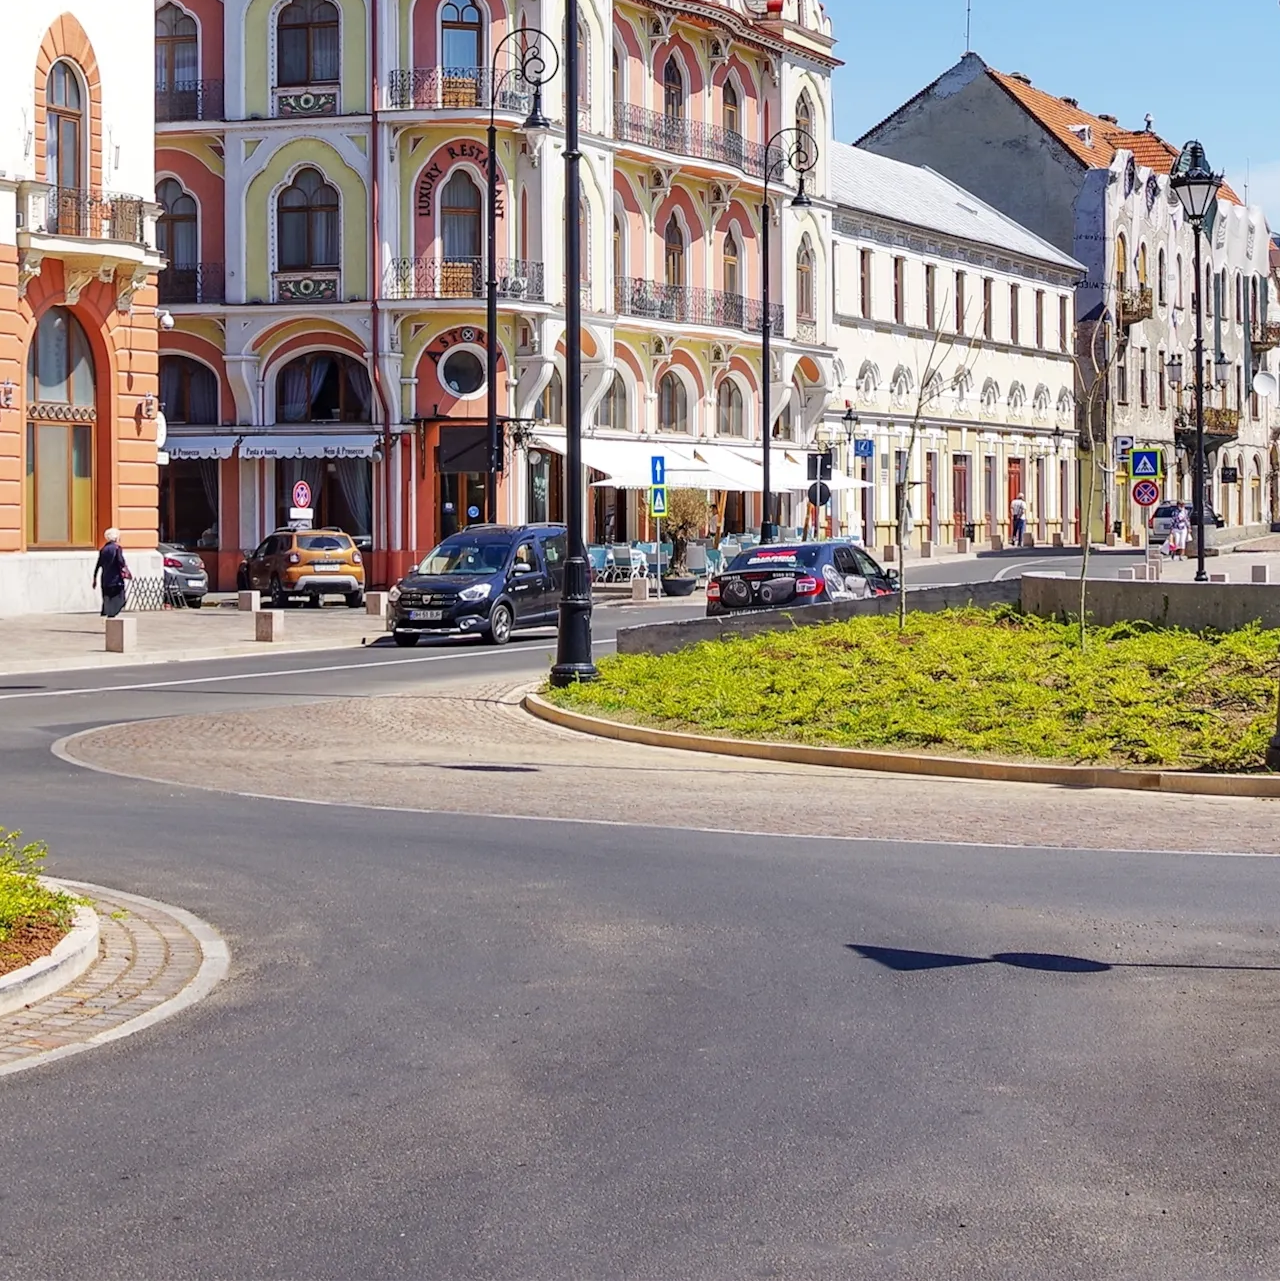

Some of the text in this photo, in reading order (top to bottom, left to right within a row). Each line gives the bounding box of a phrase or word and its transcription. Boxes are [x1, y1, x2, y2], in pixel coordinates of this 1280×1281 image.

[418, 144, 504, 221] LUXURY RESTAANT
[426, 329, 503, 366] ASTOR
[178, 447, 200, 456] Prosecco
[246, 447, 259, 456] Pasta
[342, 447, 365, 455] Prosecco
[1116, 437, 1133, 455] P
